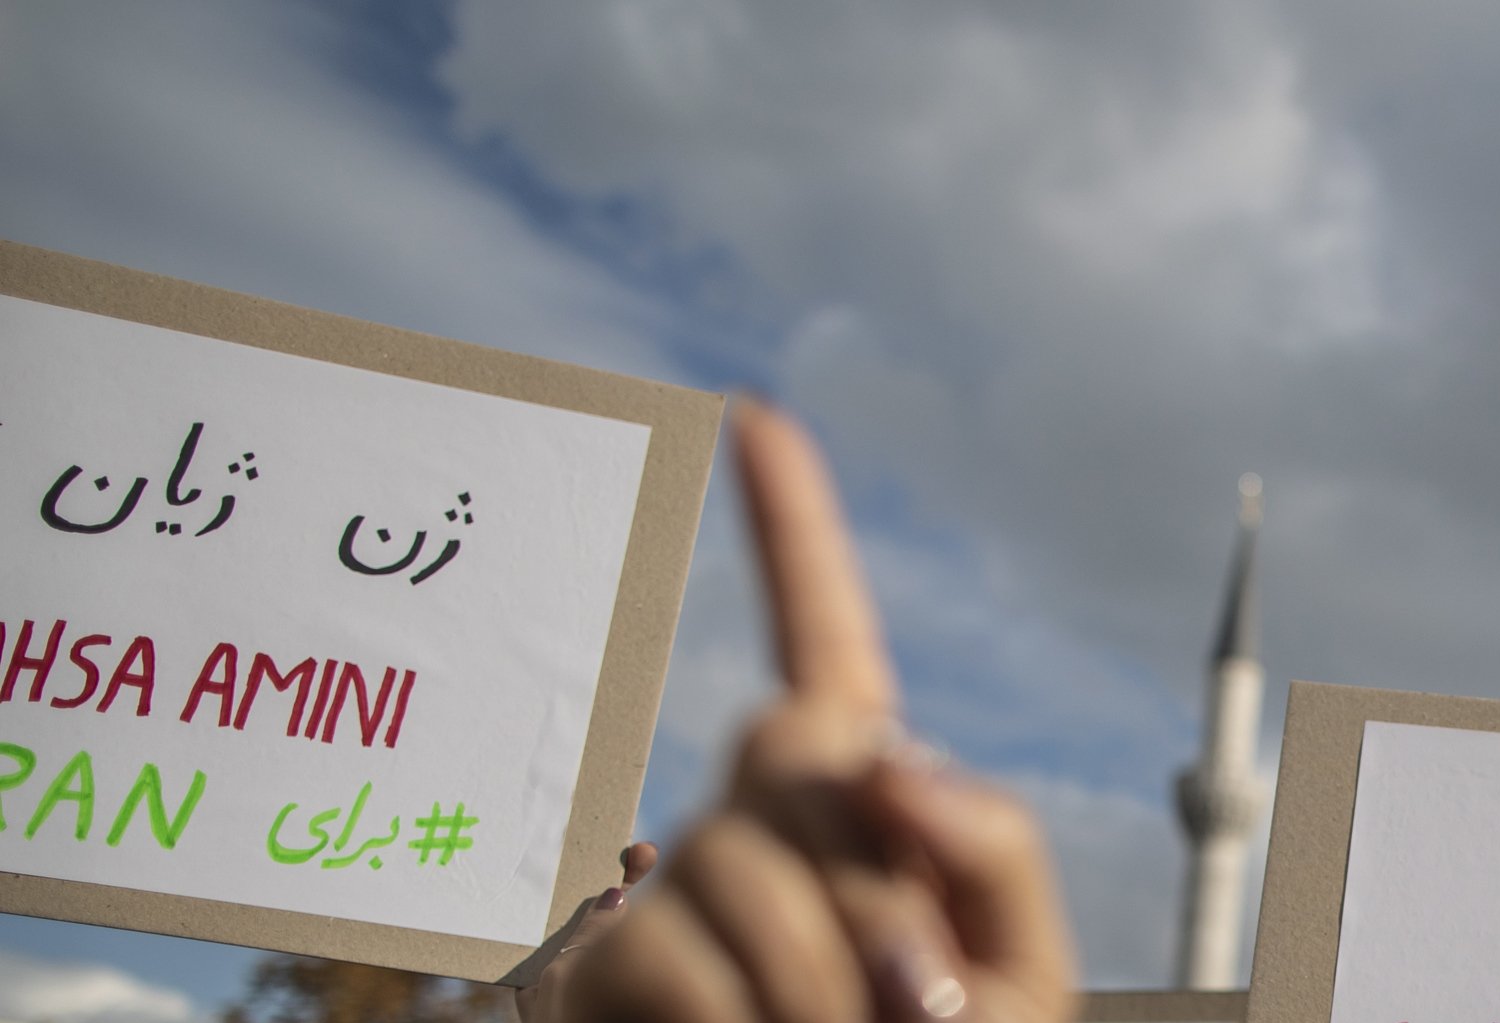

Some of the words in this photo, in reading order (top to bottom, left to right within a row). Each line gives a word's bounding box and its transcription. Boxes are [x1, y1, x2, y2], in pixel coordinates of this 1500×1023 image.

[41, 423, 258, 536] ژیان
[339, 493, 473, 585] ژن
[0, 620, 155, 716] HSA
[180, 643, 416, 748] AMINI
